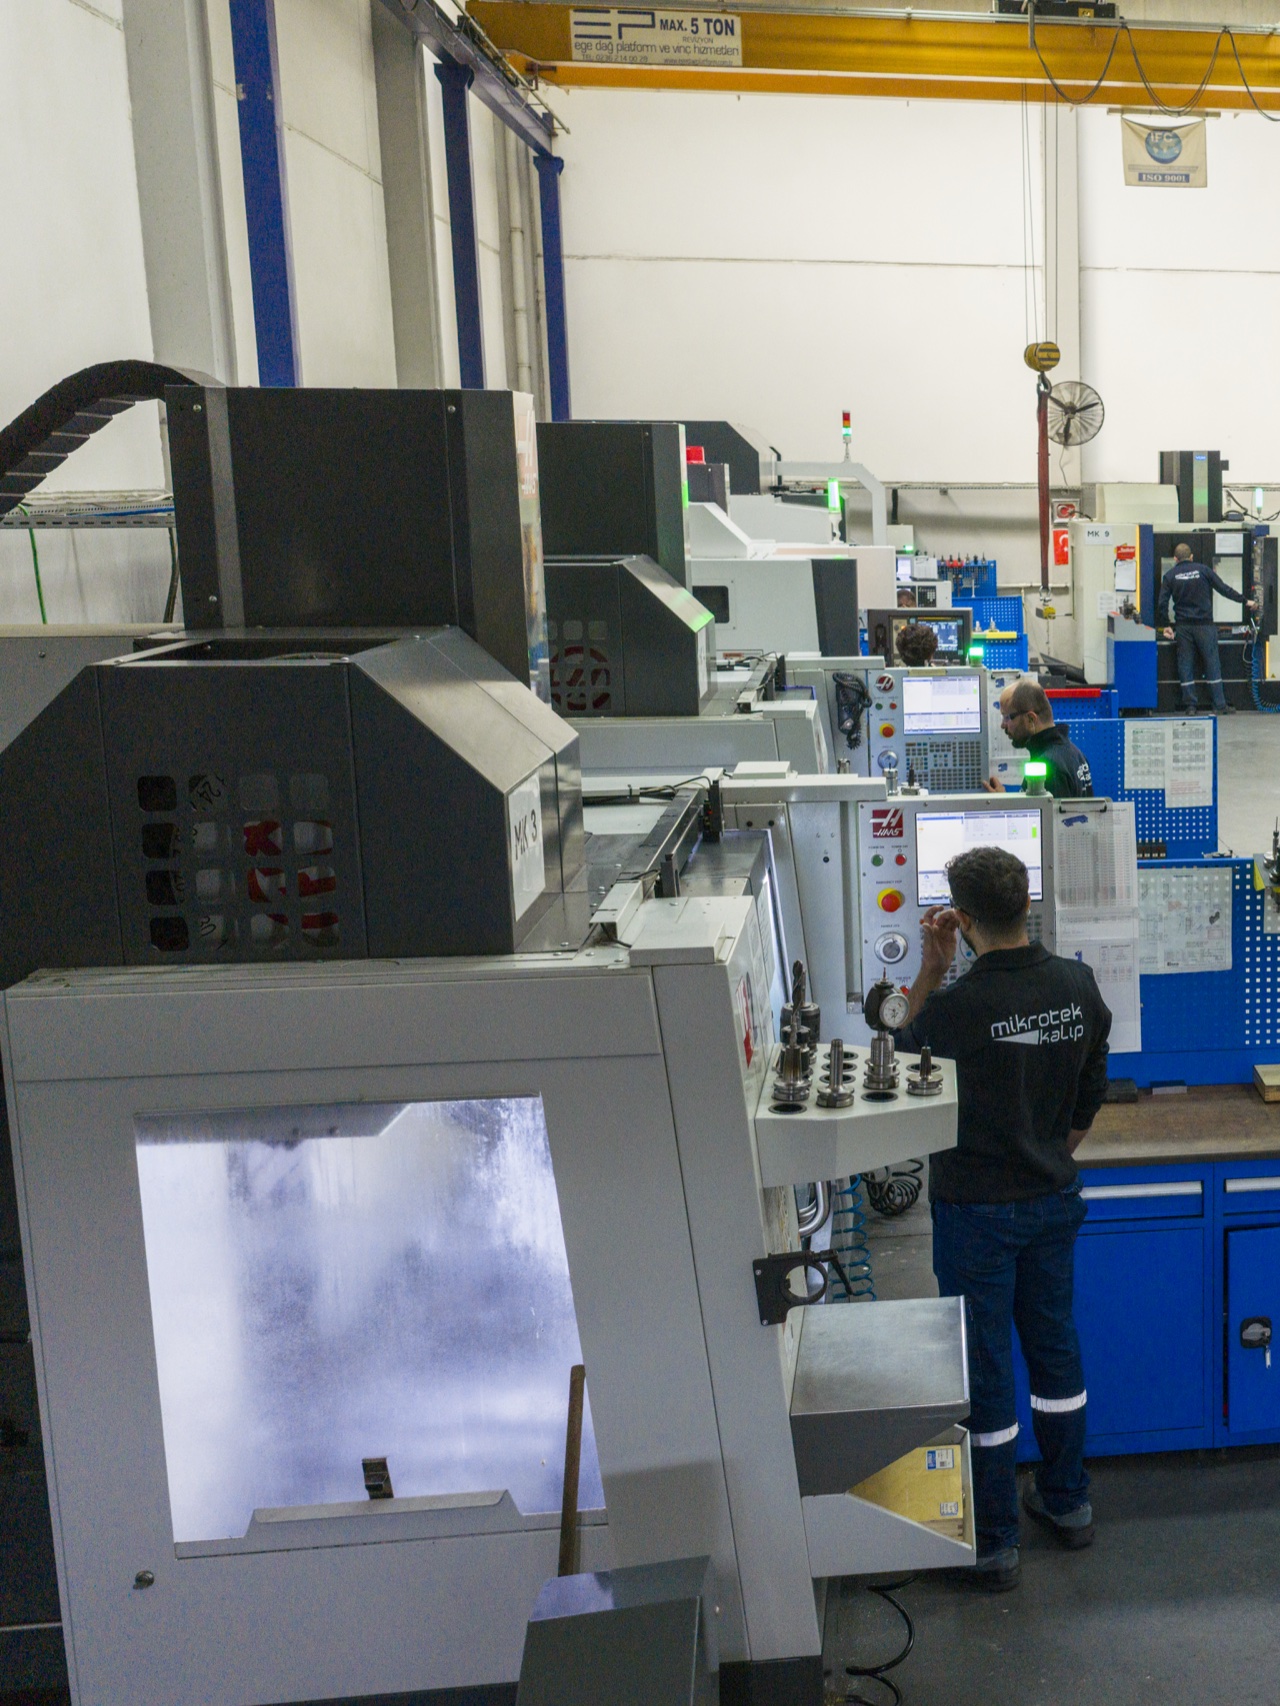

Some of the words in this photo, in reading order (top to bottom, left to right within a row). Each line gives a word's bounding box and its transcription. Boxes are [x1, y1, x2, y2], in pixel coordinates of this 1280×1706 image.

[660, 19, 687, 32] MAX.
[690, 17, 699, 35] 5
[703, 18, 735, 36] TON
[574, 42, 593, 54] ege
[595, 40, 614, 55] dağ
[616, 41, 657, 54] platform
[659, 44, 670, 53] ve
[672, 43, 691, 55] vinç
[693, 44, 739, 56] hizmetleri
[1142, 174, 1162, 182] ISO
[1164, 174, 1186, 183] 9001
[1087, 530, 1100, 538] MK
[1104, 530, 1110, 538] 9
[514, 814, 529, 861] MK
[530, 808, 538, 843] 3
[990, 1002, 1083, 1038] mikrotek
